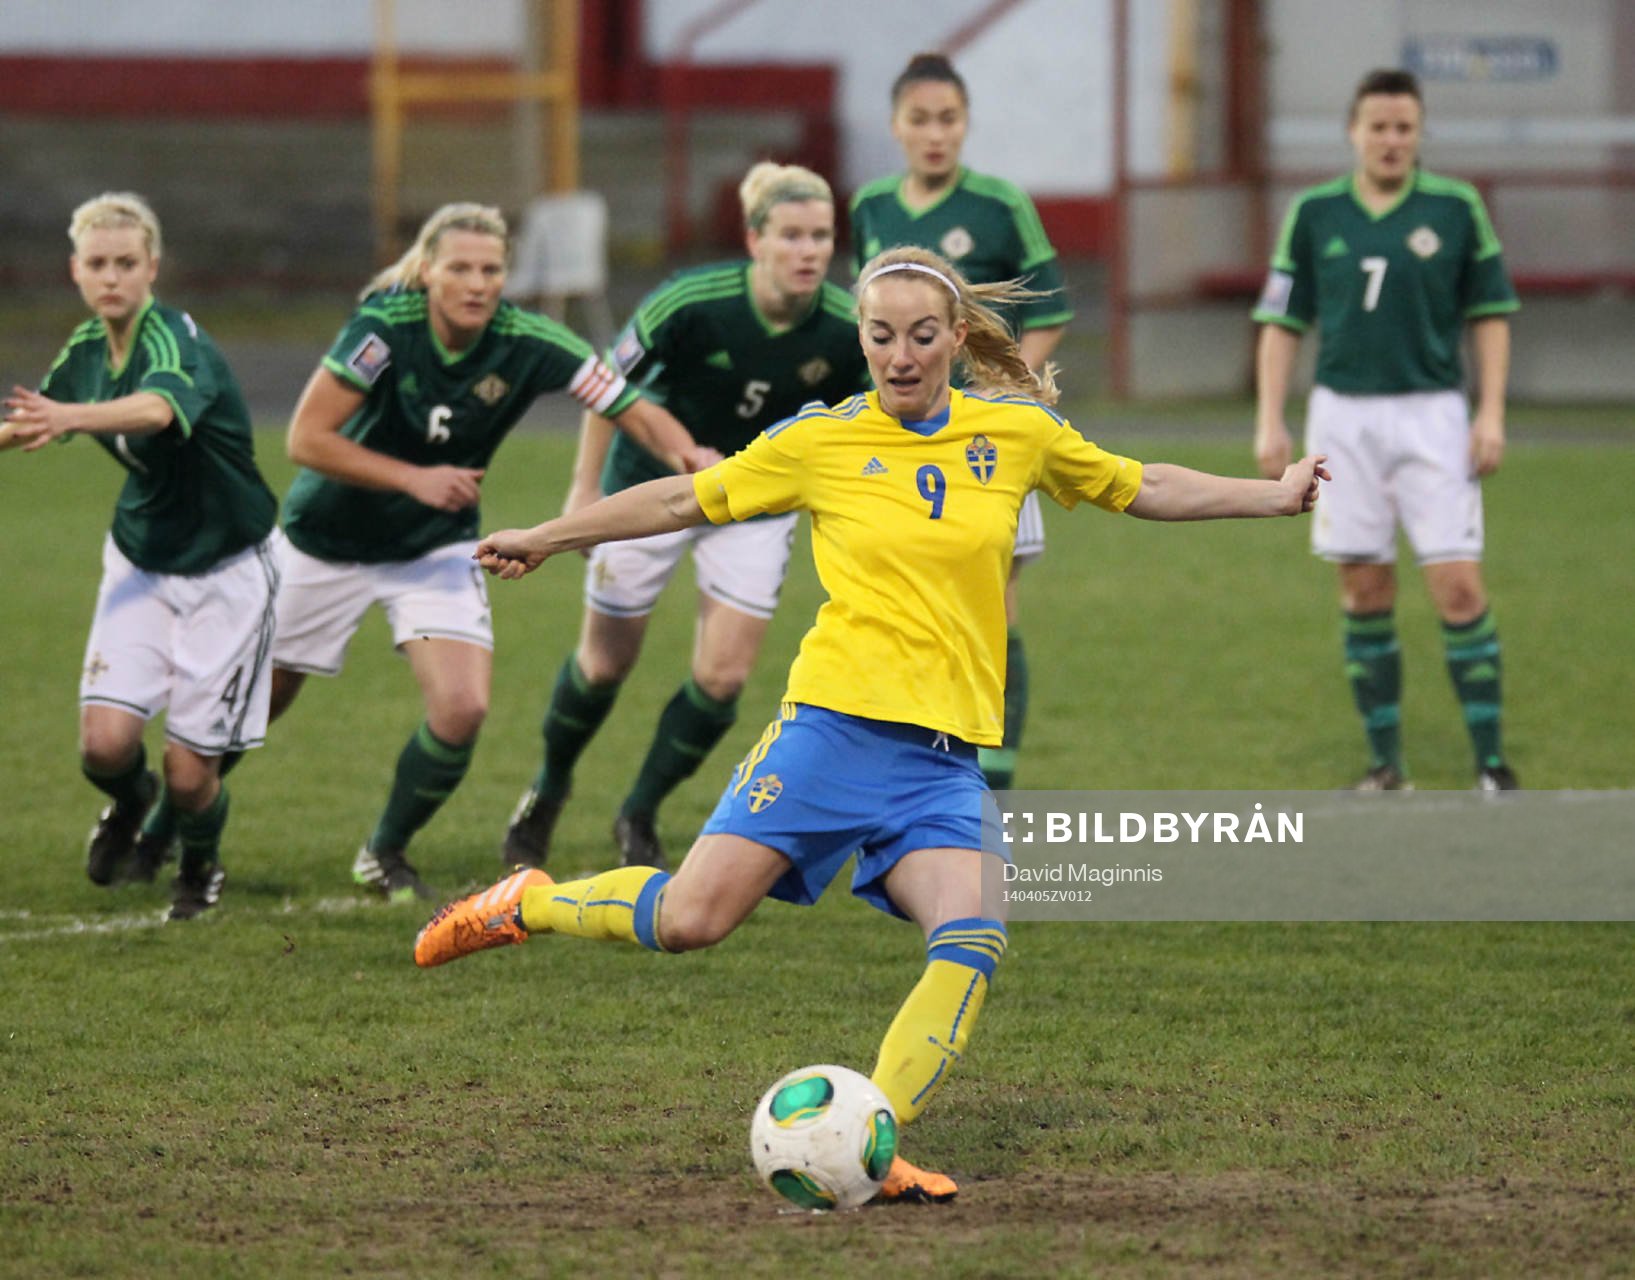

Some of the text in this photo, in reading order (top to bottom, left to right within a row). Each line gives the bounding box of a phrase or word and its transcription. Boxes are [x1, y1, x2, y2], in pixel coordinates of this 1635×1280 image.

[1360, 257, 1388, 312] 7
[736, 380, 771, 418] 5
[427, 405, 453, 443] 6
[916, 464, 946, 519] 9
[220, 665, 243, 714] 4
